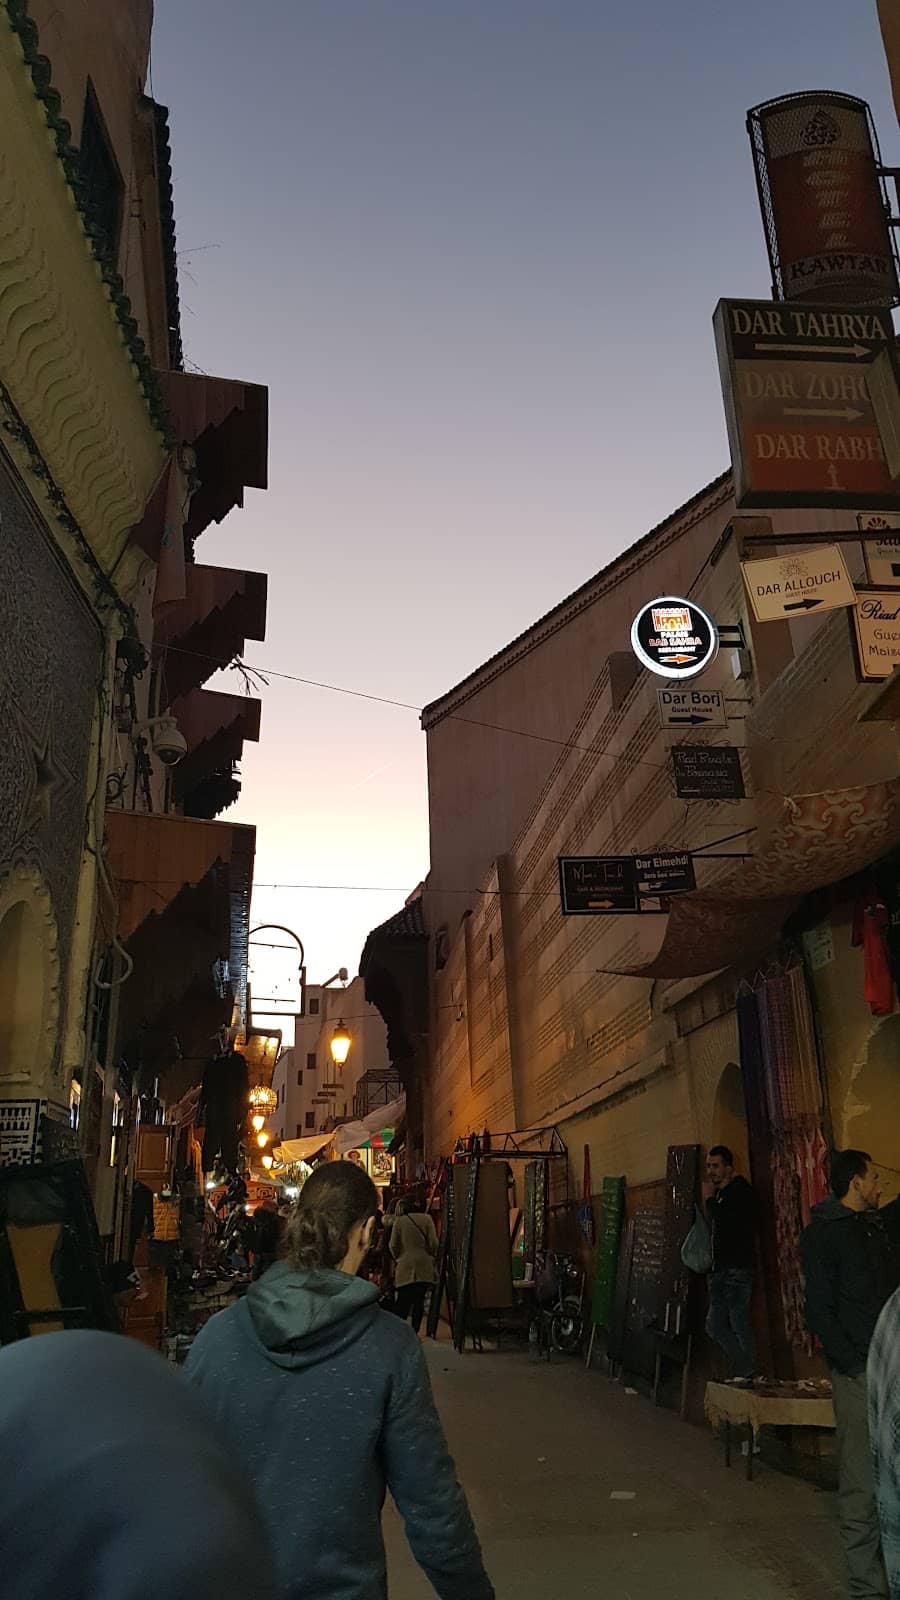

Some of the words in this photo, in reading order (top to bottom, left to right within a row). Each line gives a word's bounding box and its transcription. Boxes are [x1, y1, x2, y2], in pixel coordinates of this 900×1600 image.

[733, 309, 785, 335] DAR
[790, 312, 887, 341] TAHRYA
[745, 373, 799, 398] DAR
[756, 434, 808, 459] DAR
[757, 583, 781, 596] DAR
[785, 571, 840, 591] ALLOUCH
[860, 599, 900, 621] Riad
[662, 692, 687, 704] Dar
[691, 692, 721, 707] Borj
[635, 859, 651, 870] Dar
